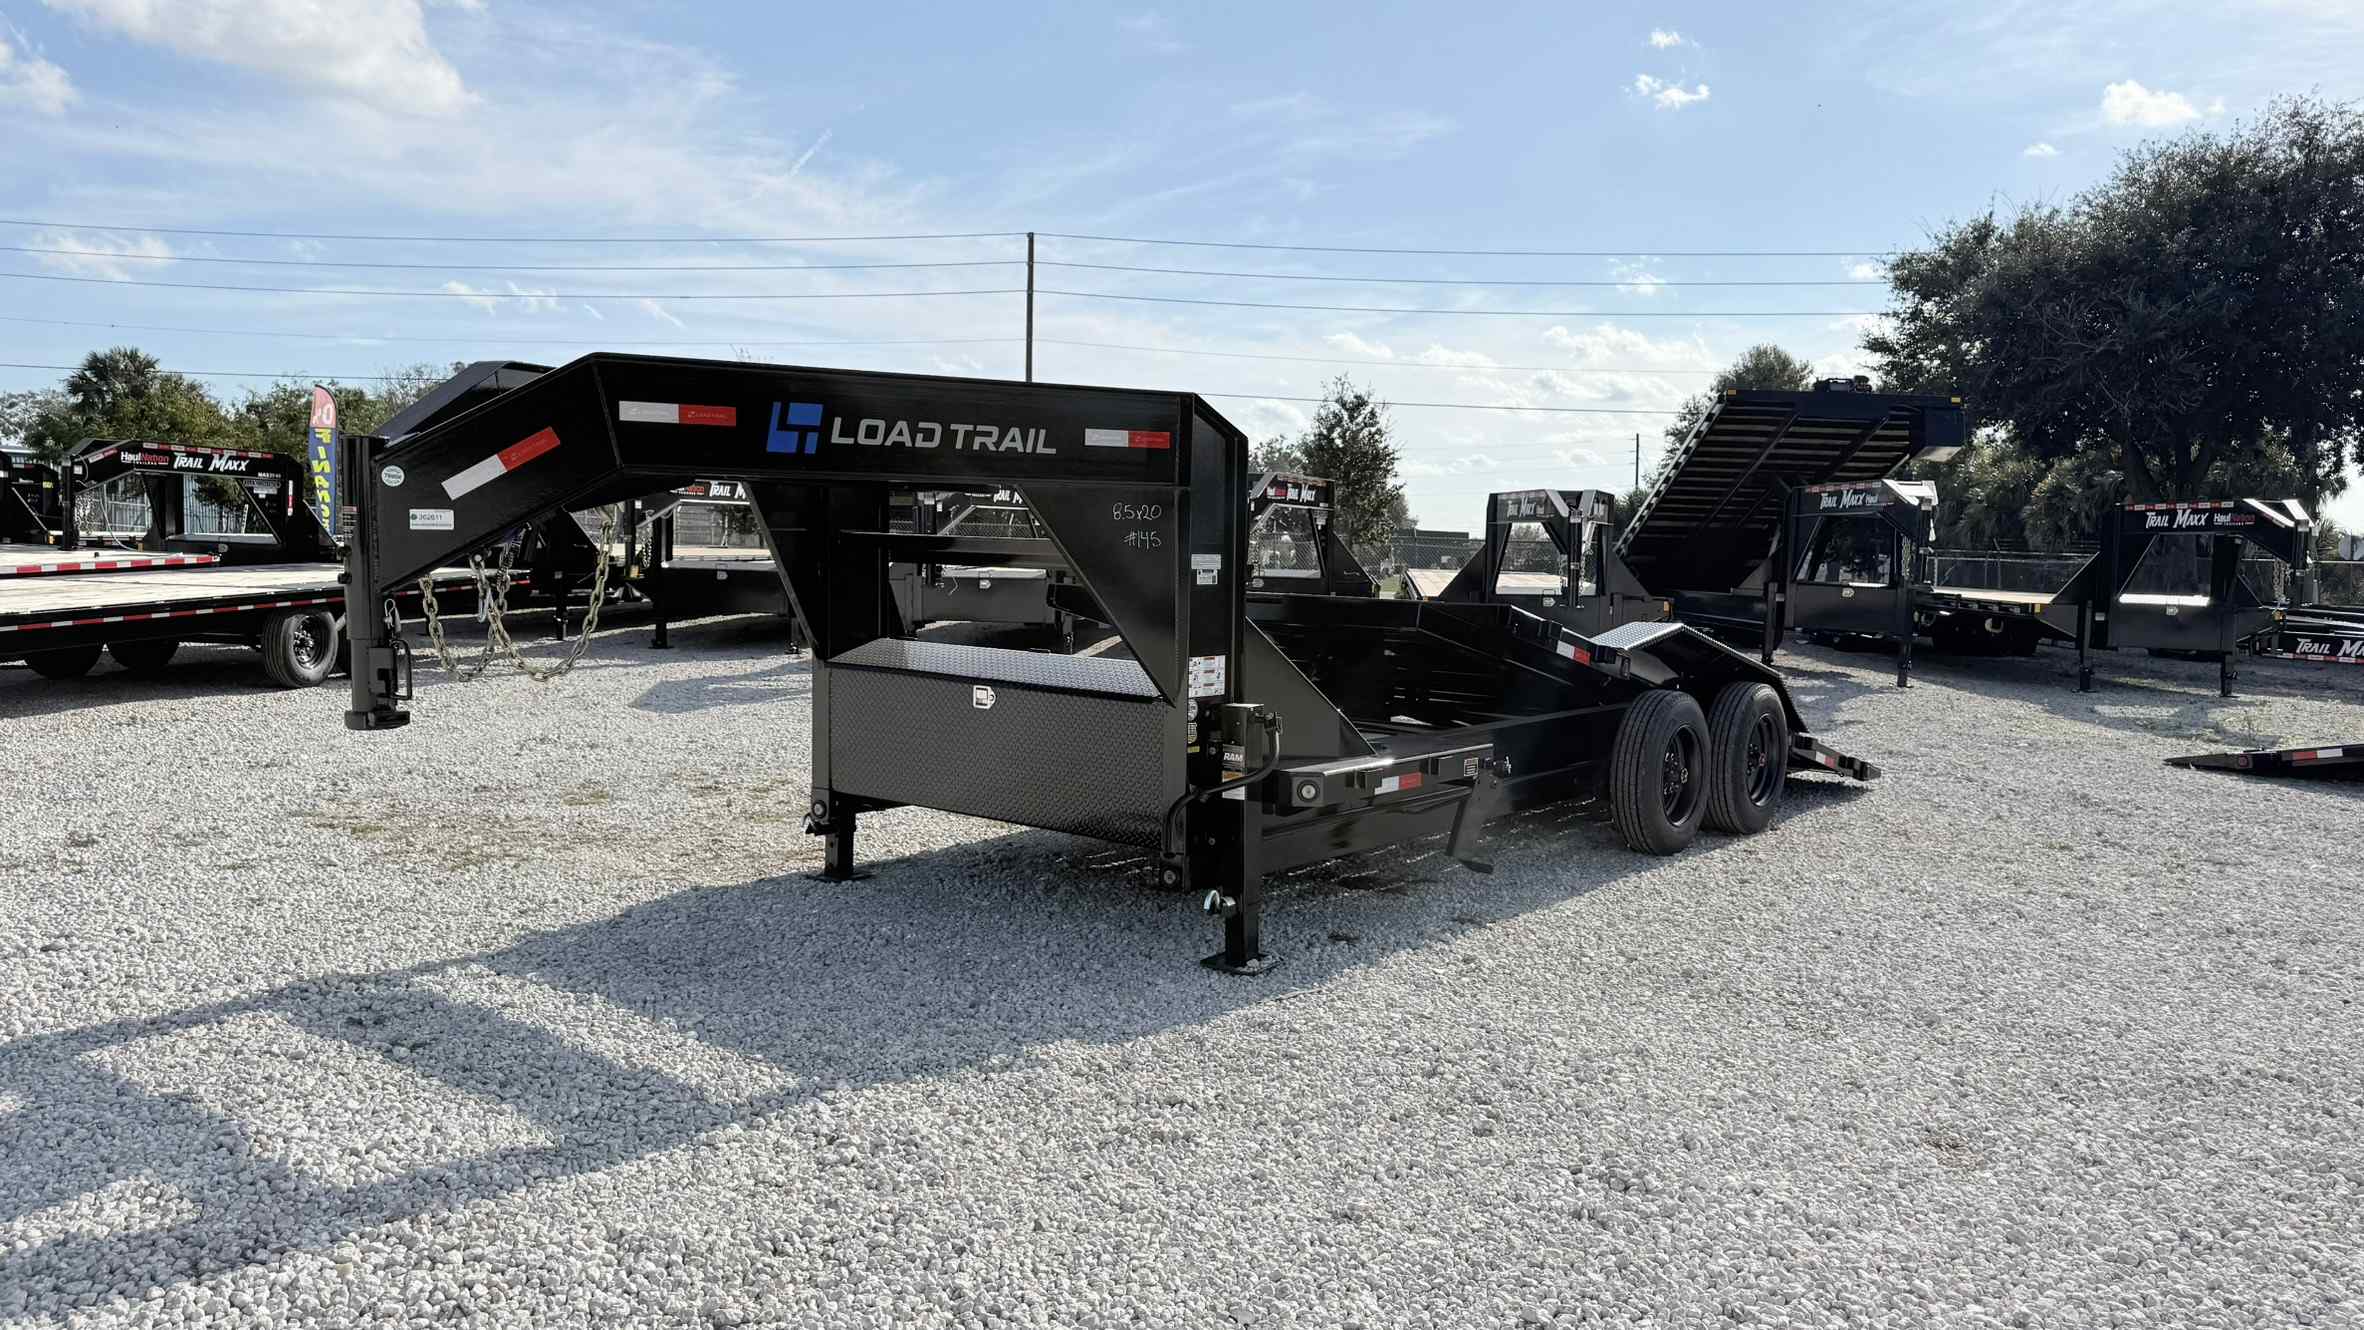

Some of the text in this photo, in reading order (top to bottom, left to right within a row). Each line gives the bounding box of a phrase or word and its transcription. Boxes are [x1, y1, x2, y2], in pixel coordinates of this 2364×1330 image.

[831, 416, 943, 448] LOAD
[950, 423, 1057, 454] TRAIL
[173, 452, 203, 469] TRAIL
[208, 453, 249, 471] MAXX
[2145, 511, 2169, 529] TRAIL
[2173, 509, 2208, 529] MAXX
[1123, 529, 1162, 550] #145
[2295, 638, 2331, 654] TRAIL
[1223, 752, 1244, 761] RAM
